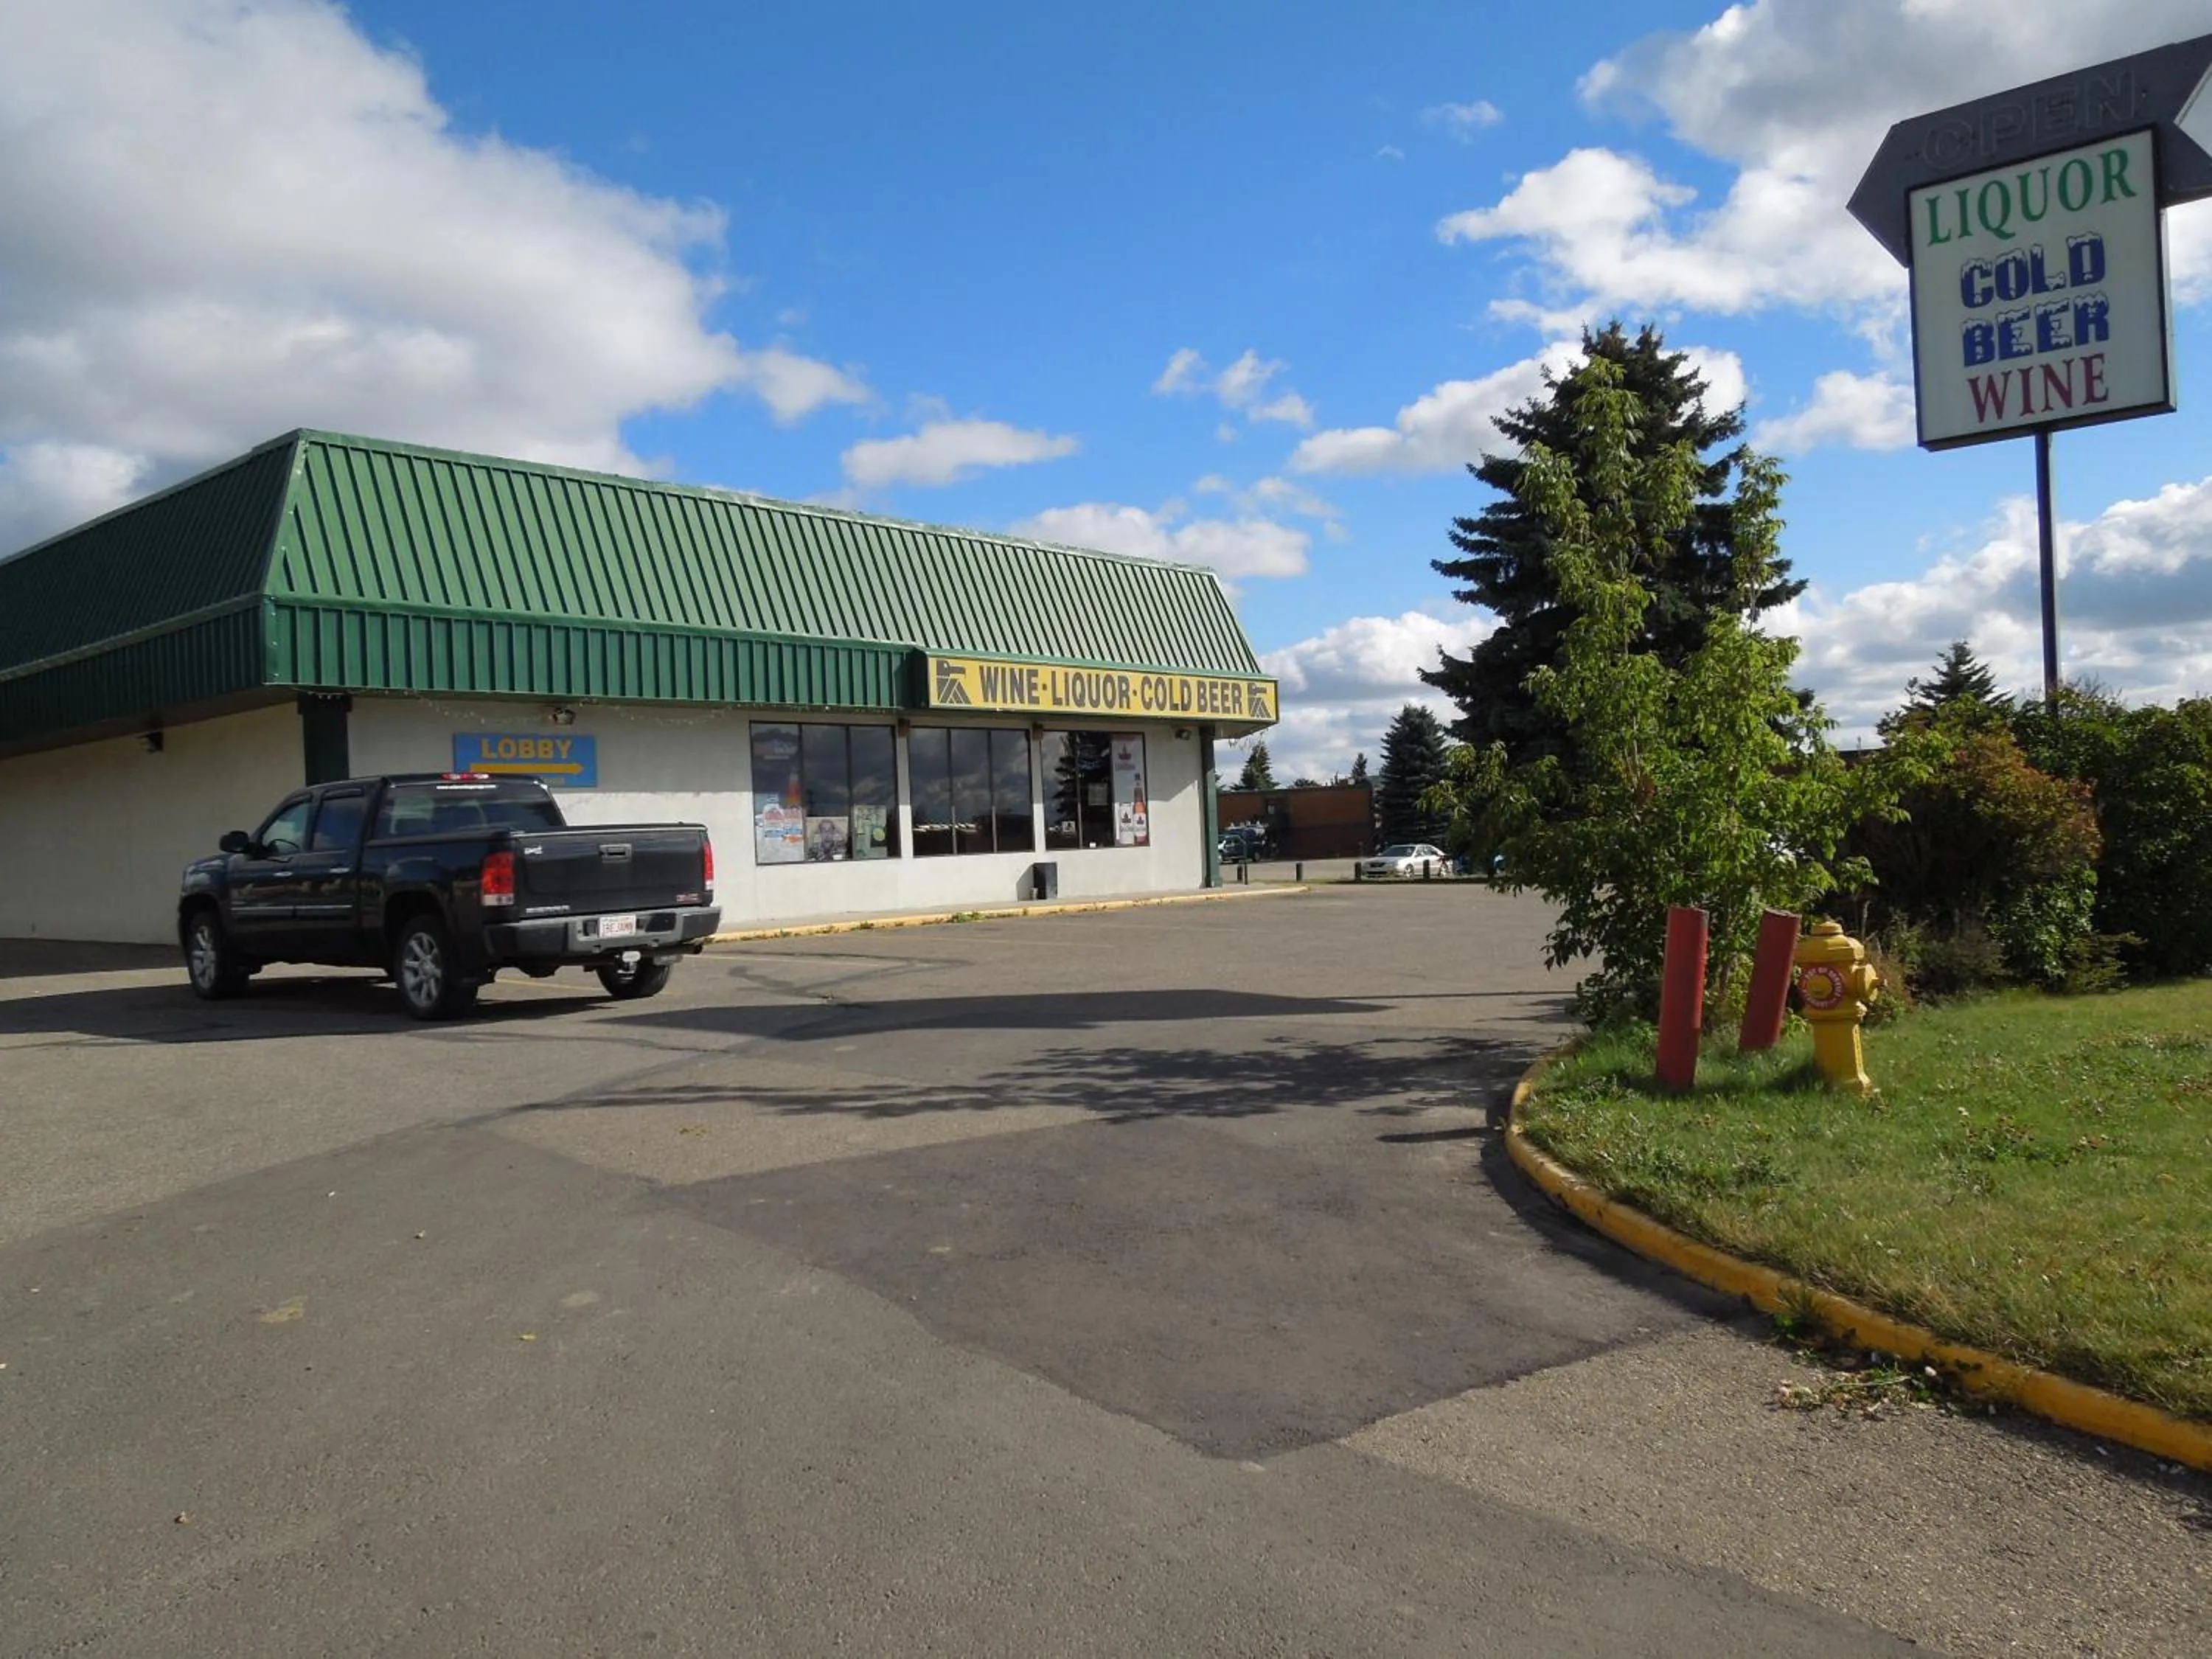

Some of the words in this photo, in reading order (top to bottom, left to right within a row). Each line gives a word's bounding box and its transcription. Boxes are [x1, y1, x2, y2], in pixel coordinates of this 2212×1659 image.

[1921, 70, 2136, 171] OPEN
[1925, 148, 2137, 247] LIQUOR
[1960, 231, 2107, 309] COLD
[1961, 291, 2110, 368] BEER
[1966, 353, 2110, 424] WINE
[978, 664, 1040, 706] WINE
[1051, 670, 1131, 710] LIQUOR
[1141, 675, 1192, 712] COLD
[1197, 679, 1243, 714] BEER
[481, 739, 572, 759] LOBBY
